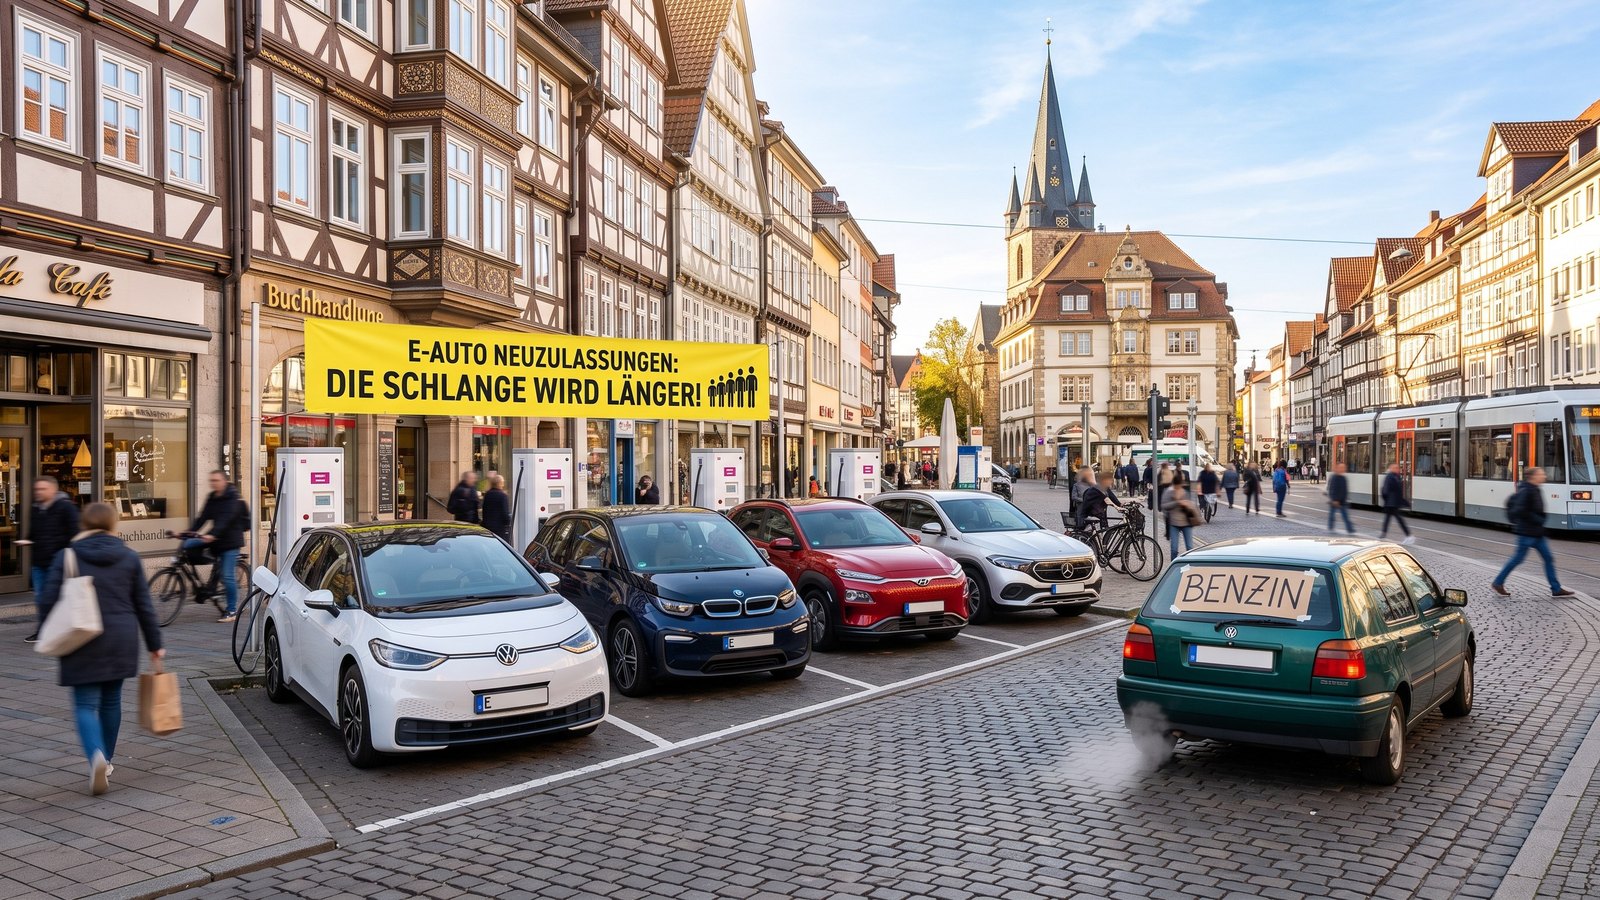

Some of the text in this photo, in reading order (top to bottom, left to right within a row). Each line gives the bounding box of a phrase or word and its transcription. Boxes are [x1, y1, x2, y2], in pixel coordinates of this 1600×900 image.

[48, 262, 112, 306] Café
[408, 339, 679, 374] E-AUTO NEUZULASSUNGEN:
[327, 368, 701, 408] DIE SCHLANGE WIRD LÄNGER!
[1182, 574, 1305, 609] BENZIN
[729, 638, 734, 648] E
[484, 696, 491, 709] E
